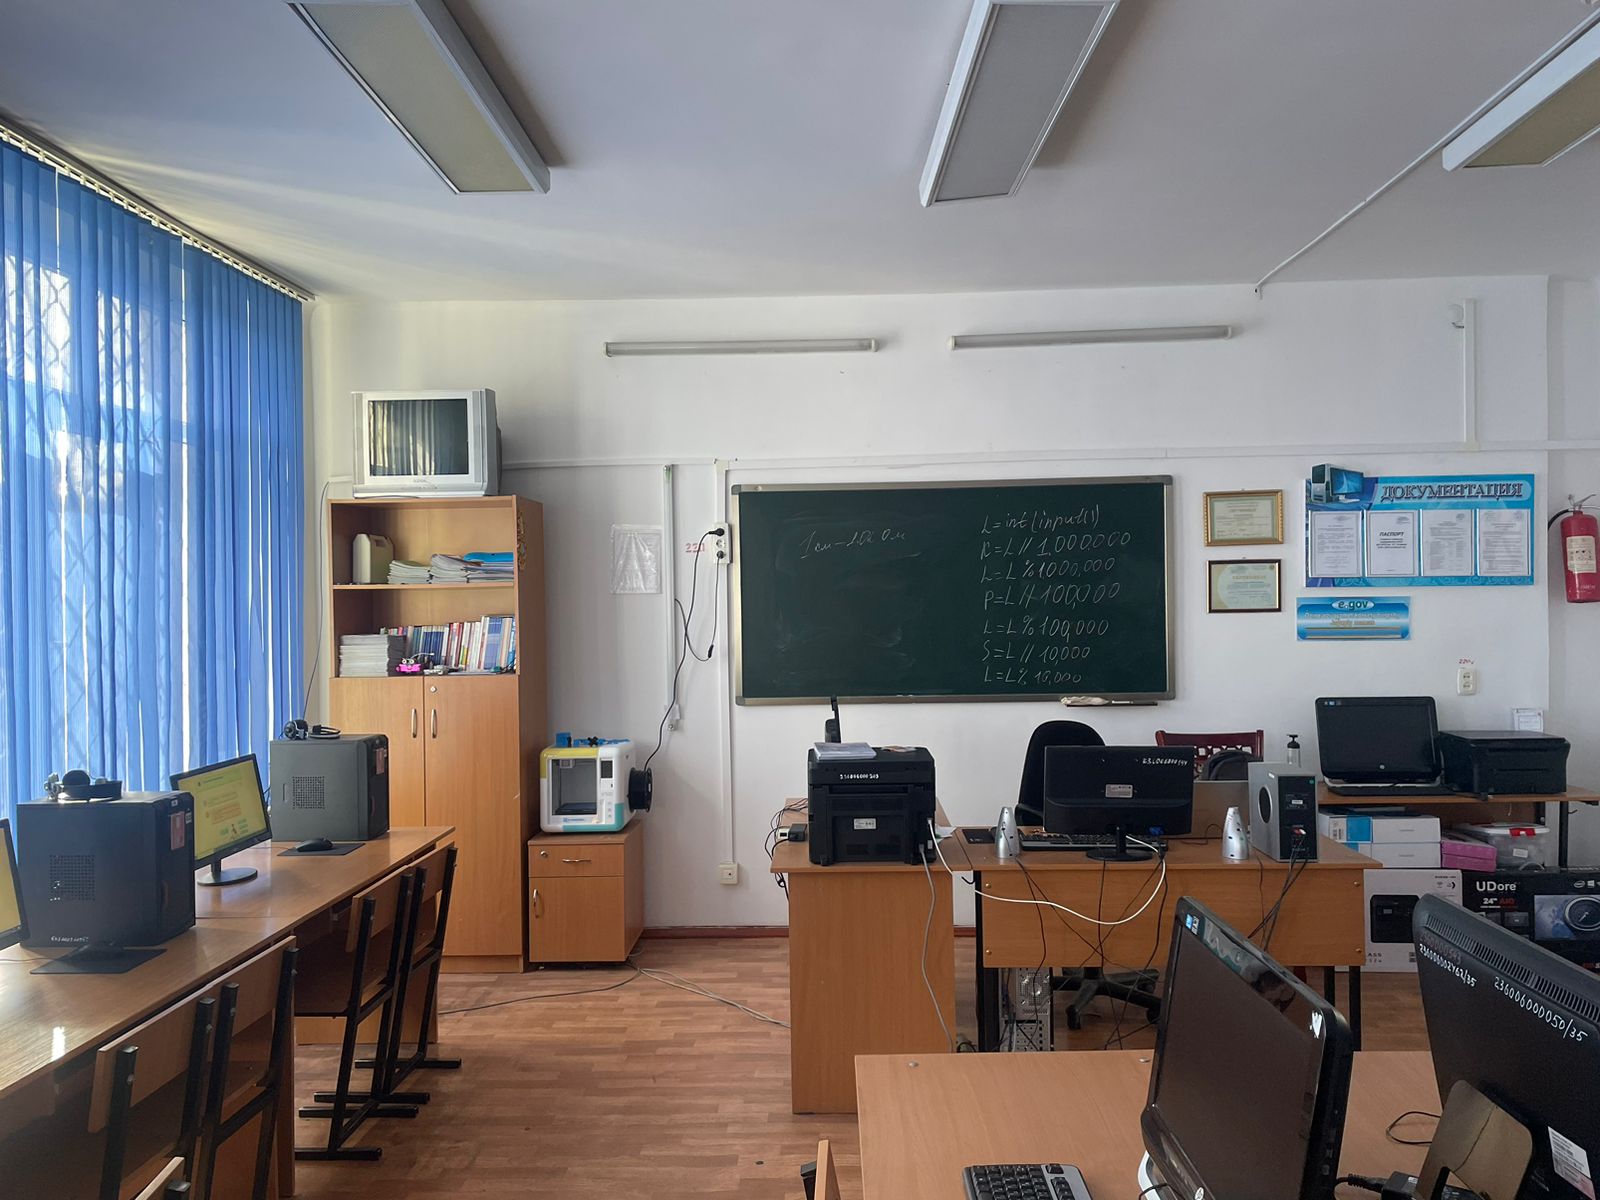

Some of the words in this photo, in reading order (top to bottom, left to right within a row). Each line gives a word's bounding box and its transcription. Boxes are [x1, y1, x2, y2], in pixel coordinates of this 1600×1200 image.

[1380, 483, 1523, 502] ДОКУМЕНТАЦИЯ
[1338, 600, 1369, 611] e.gov
[1476, 881, 1517, 892] UDore
